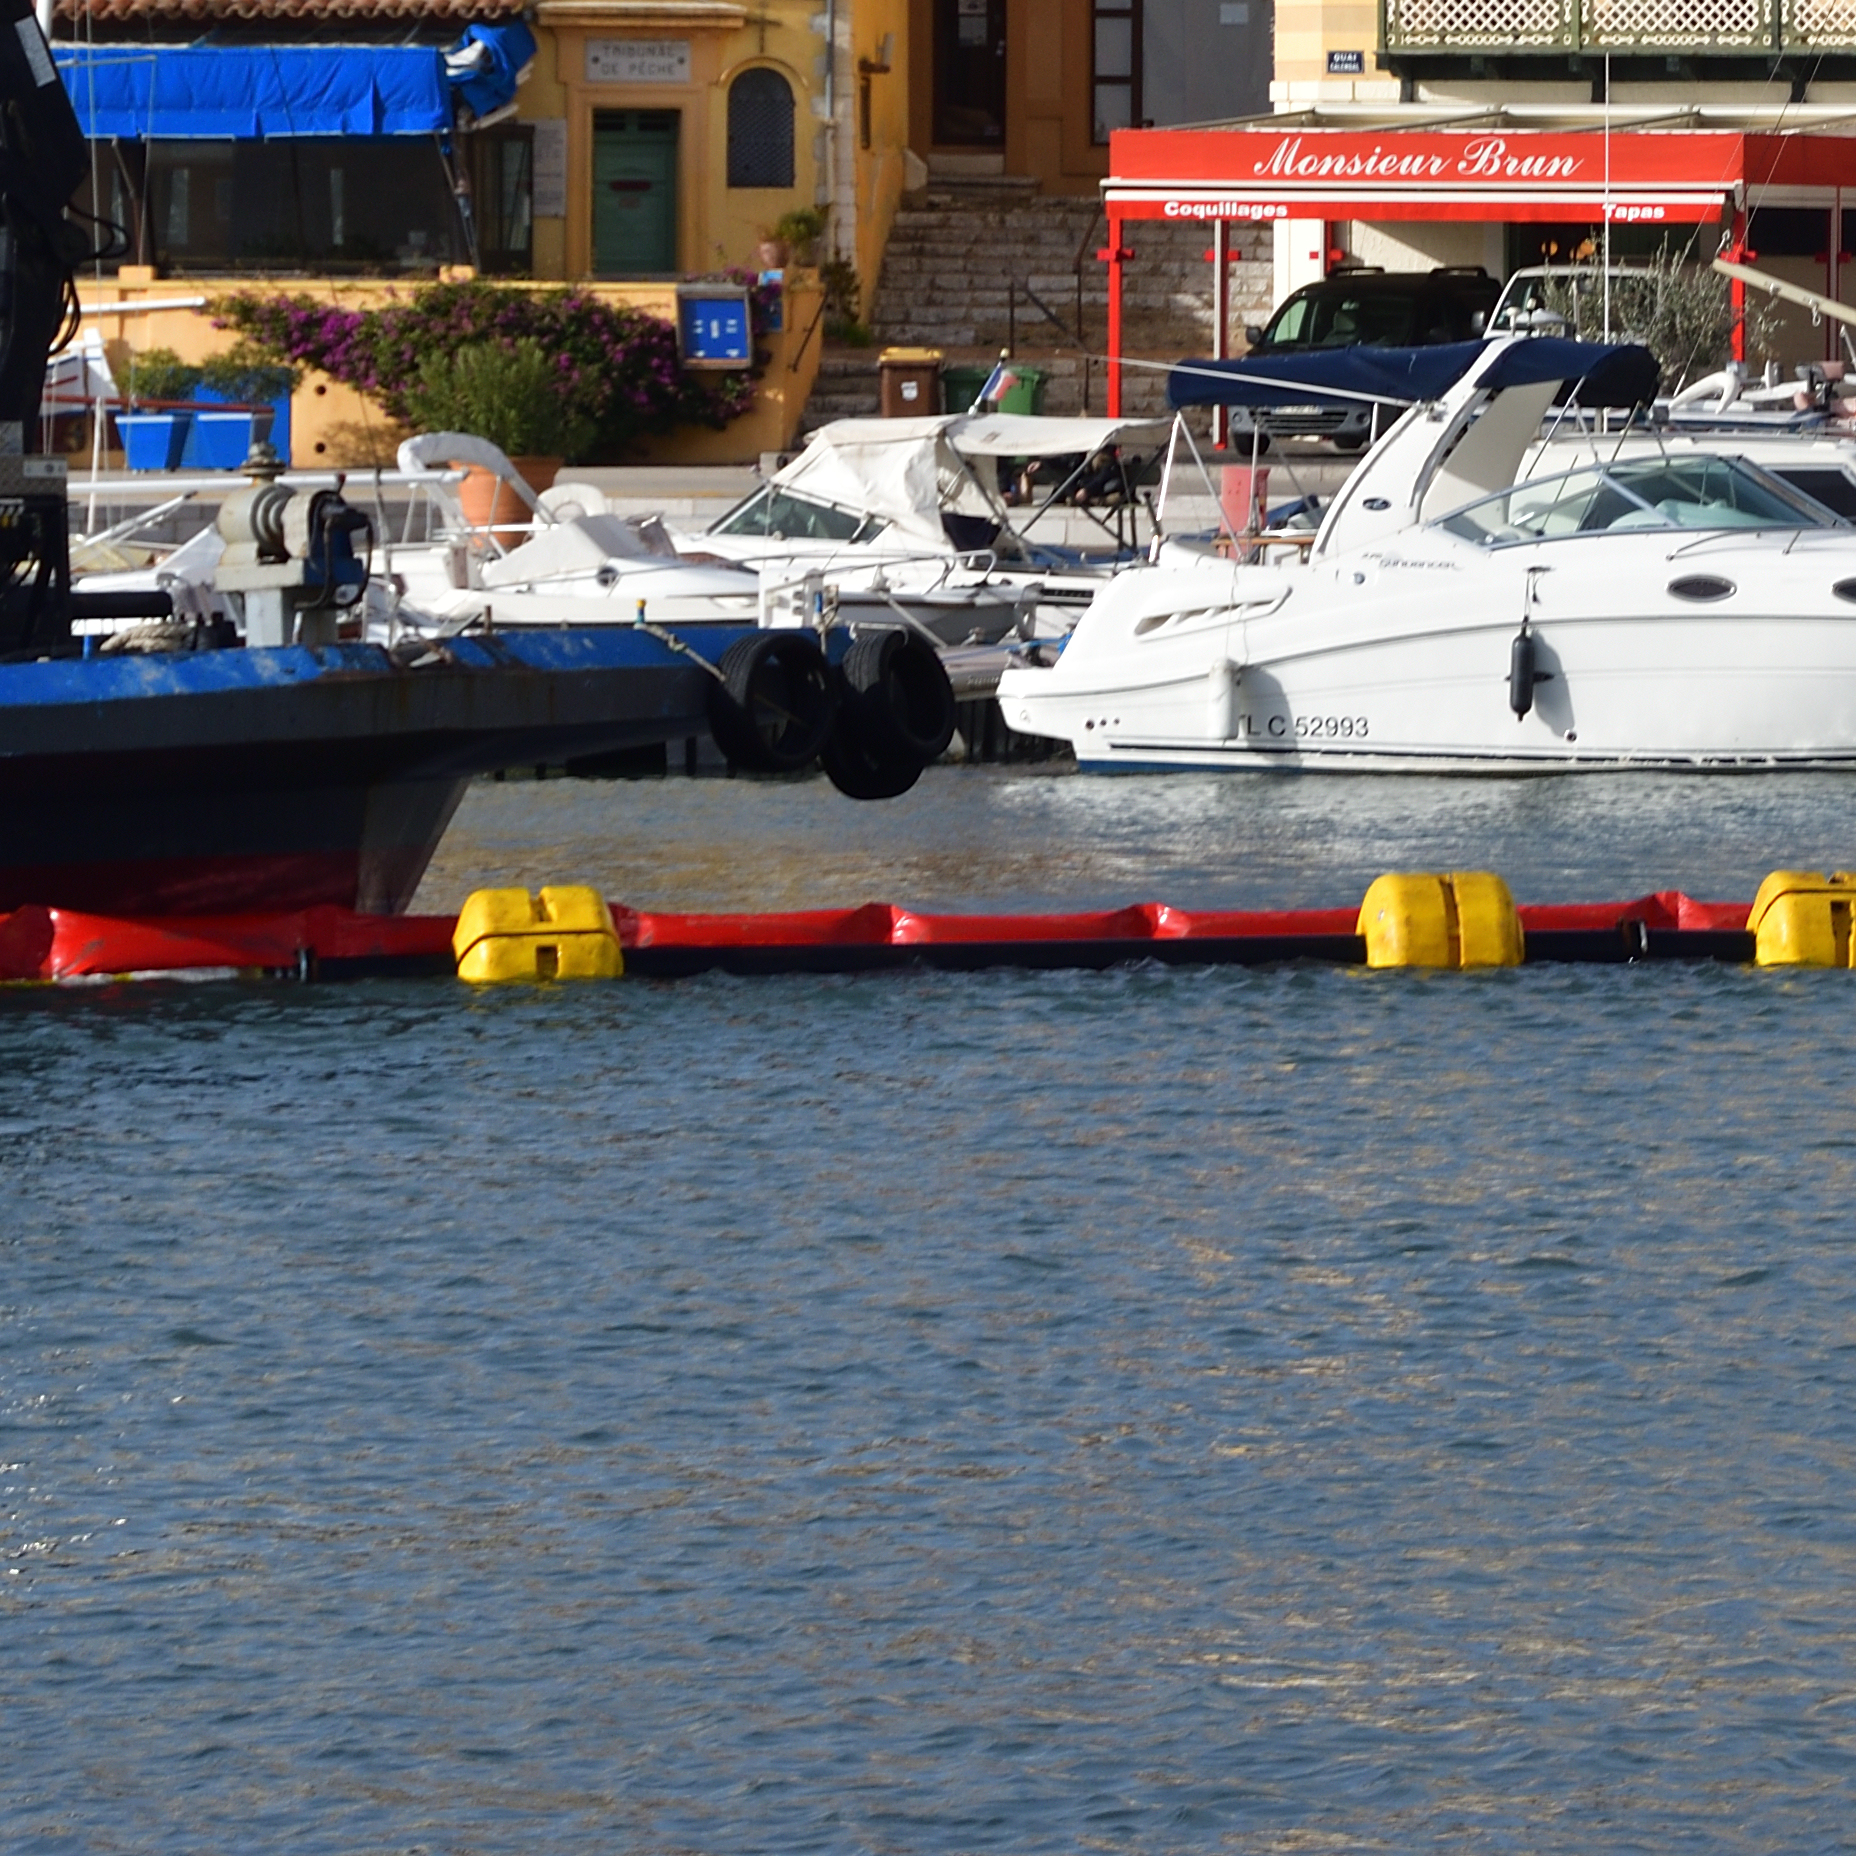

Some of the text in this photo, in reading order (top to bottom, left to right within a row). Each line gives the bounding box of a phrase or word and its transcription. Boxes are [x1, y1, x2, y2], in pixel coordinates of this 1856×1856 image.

[1333, 52, 1358, 62] QUAI
[1253, 136, 1585, 178] Monsieur Brun
[1164, 200, 1665, 221] Coquillages Tapas
[1295, 715, 1369, 738] 52993
